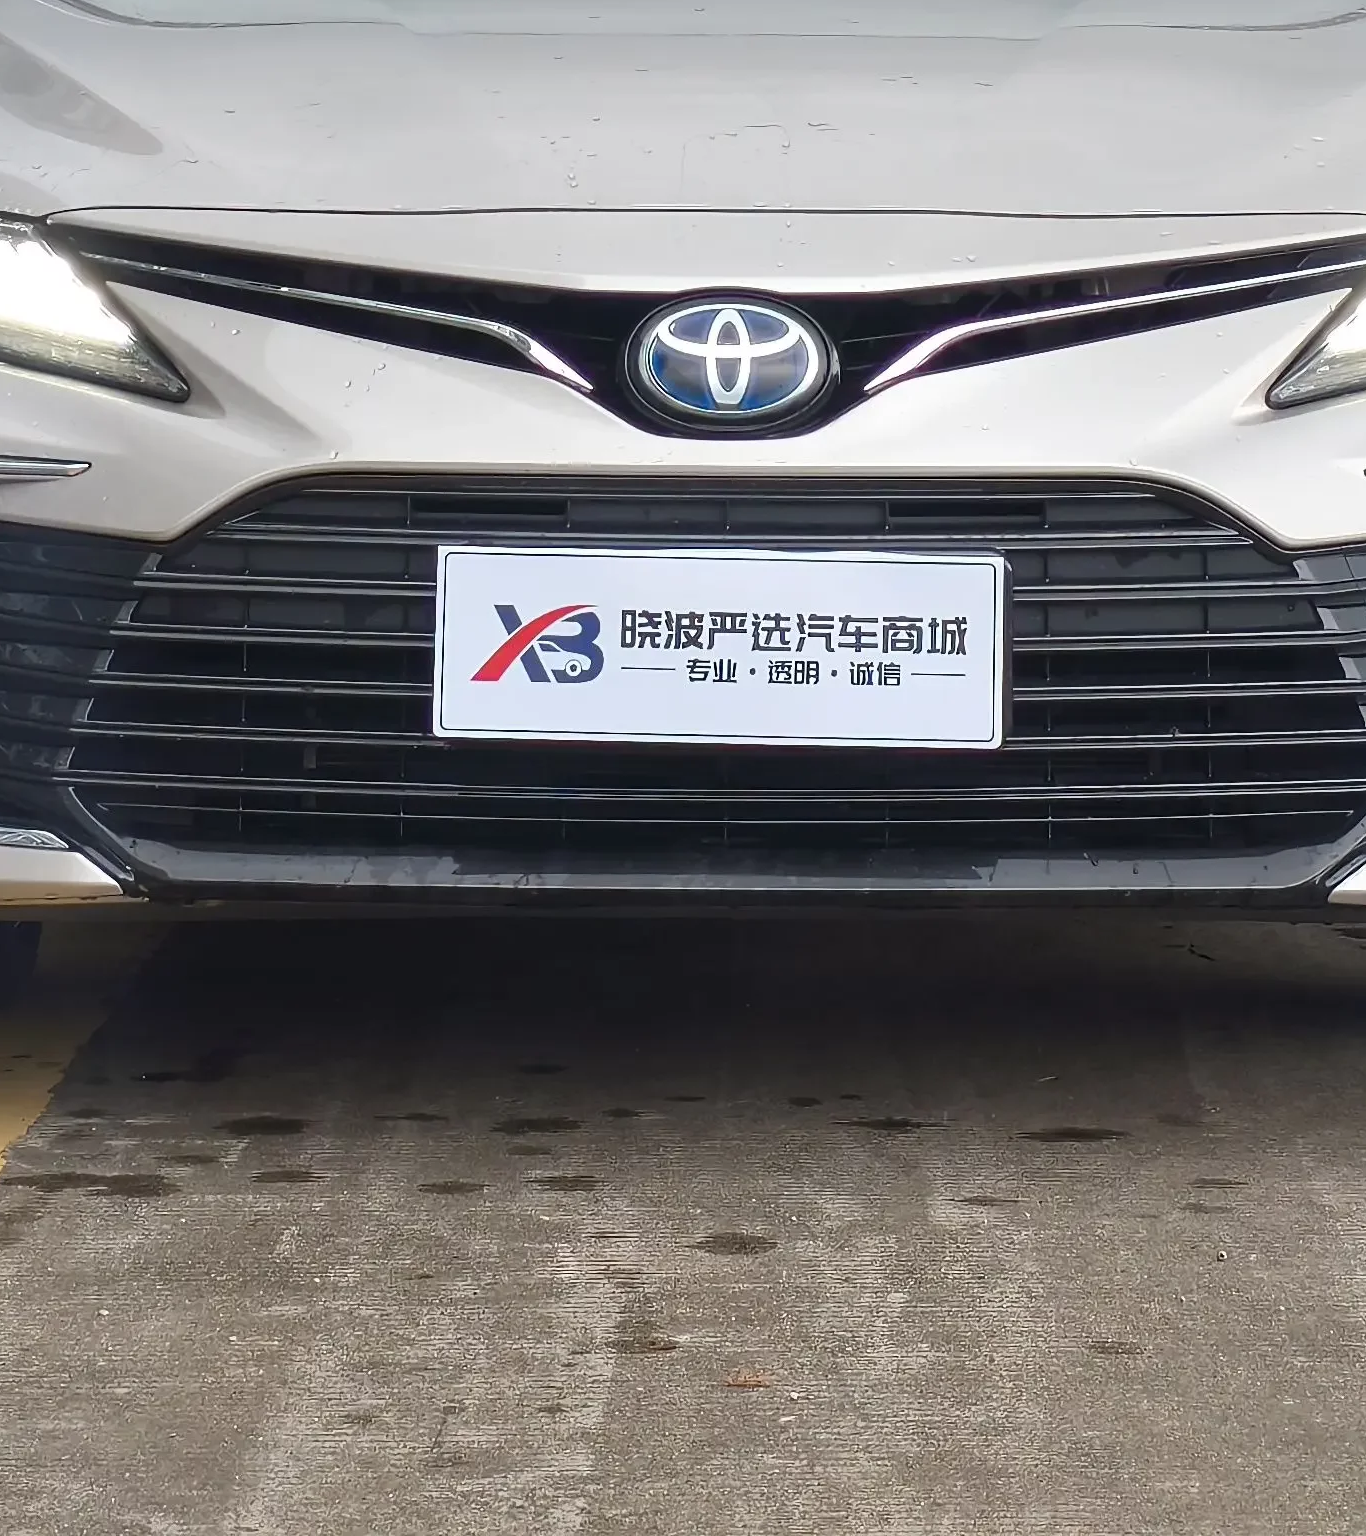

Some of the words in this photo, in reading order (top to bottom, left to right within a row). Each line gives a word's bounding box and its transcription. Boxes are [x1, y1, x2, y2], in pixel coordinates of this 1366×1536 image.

[621, 608, 968, 657] 晓波严选汽车商城
